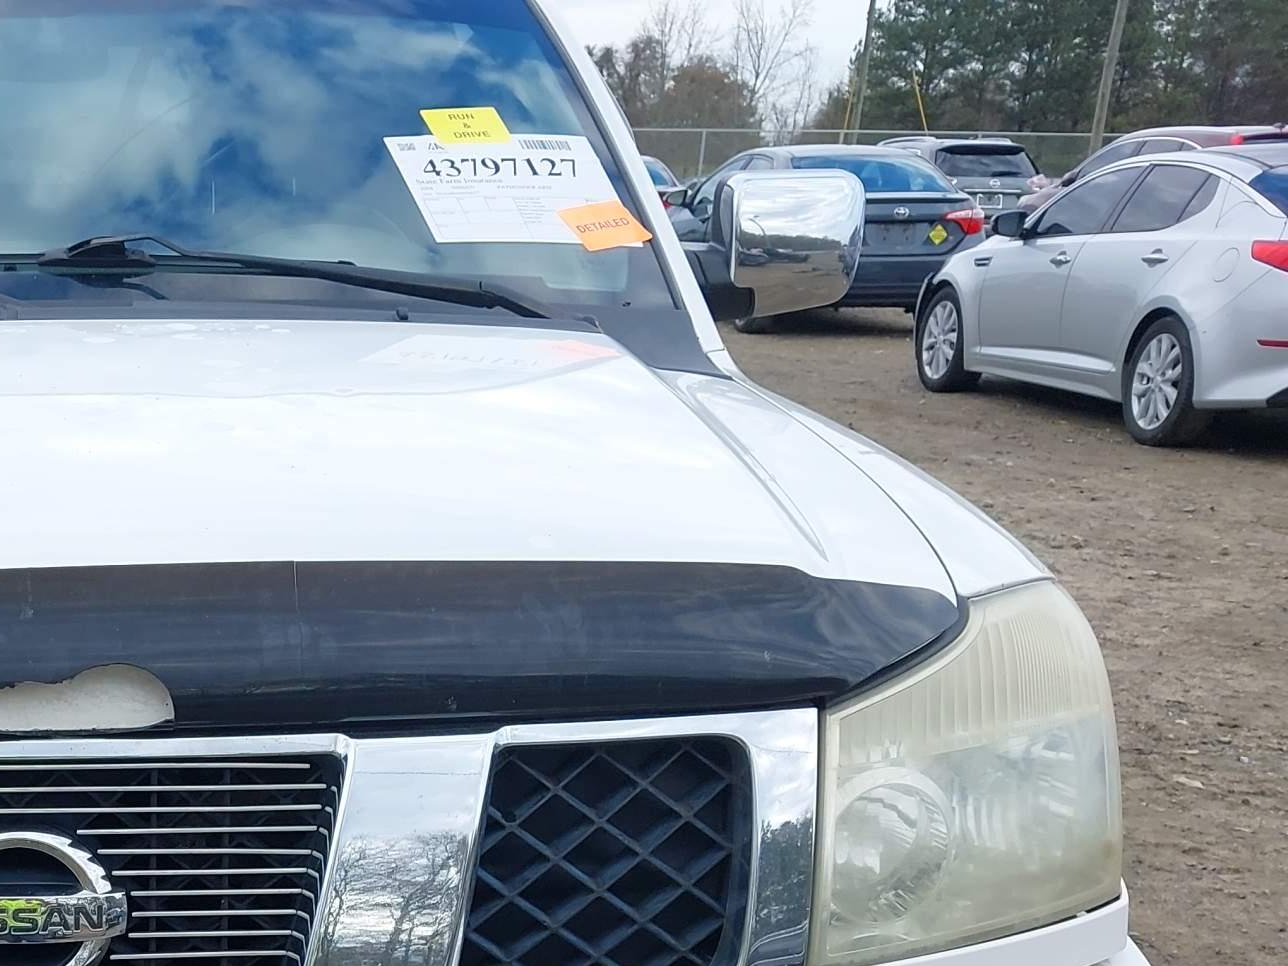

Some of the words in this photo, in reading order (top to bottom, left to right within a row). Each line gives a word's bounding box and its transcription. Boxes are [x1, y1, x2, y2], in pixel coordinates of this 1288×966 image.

[447, 113, 475, 121] RUN
[453, 131, 492, 139] DRIVE
[423, 157, 577, 178] 43797127
[575, 216, 631, 234] DETAILED
